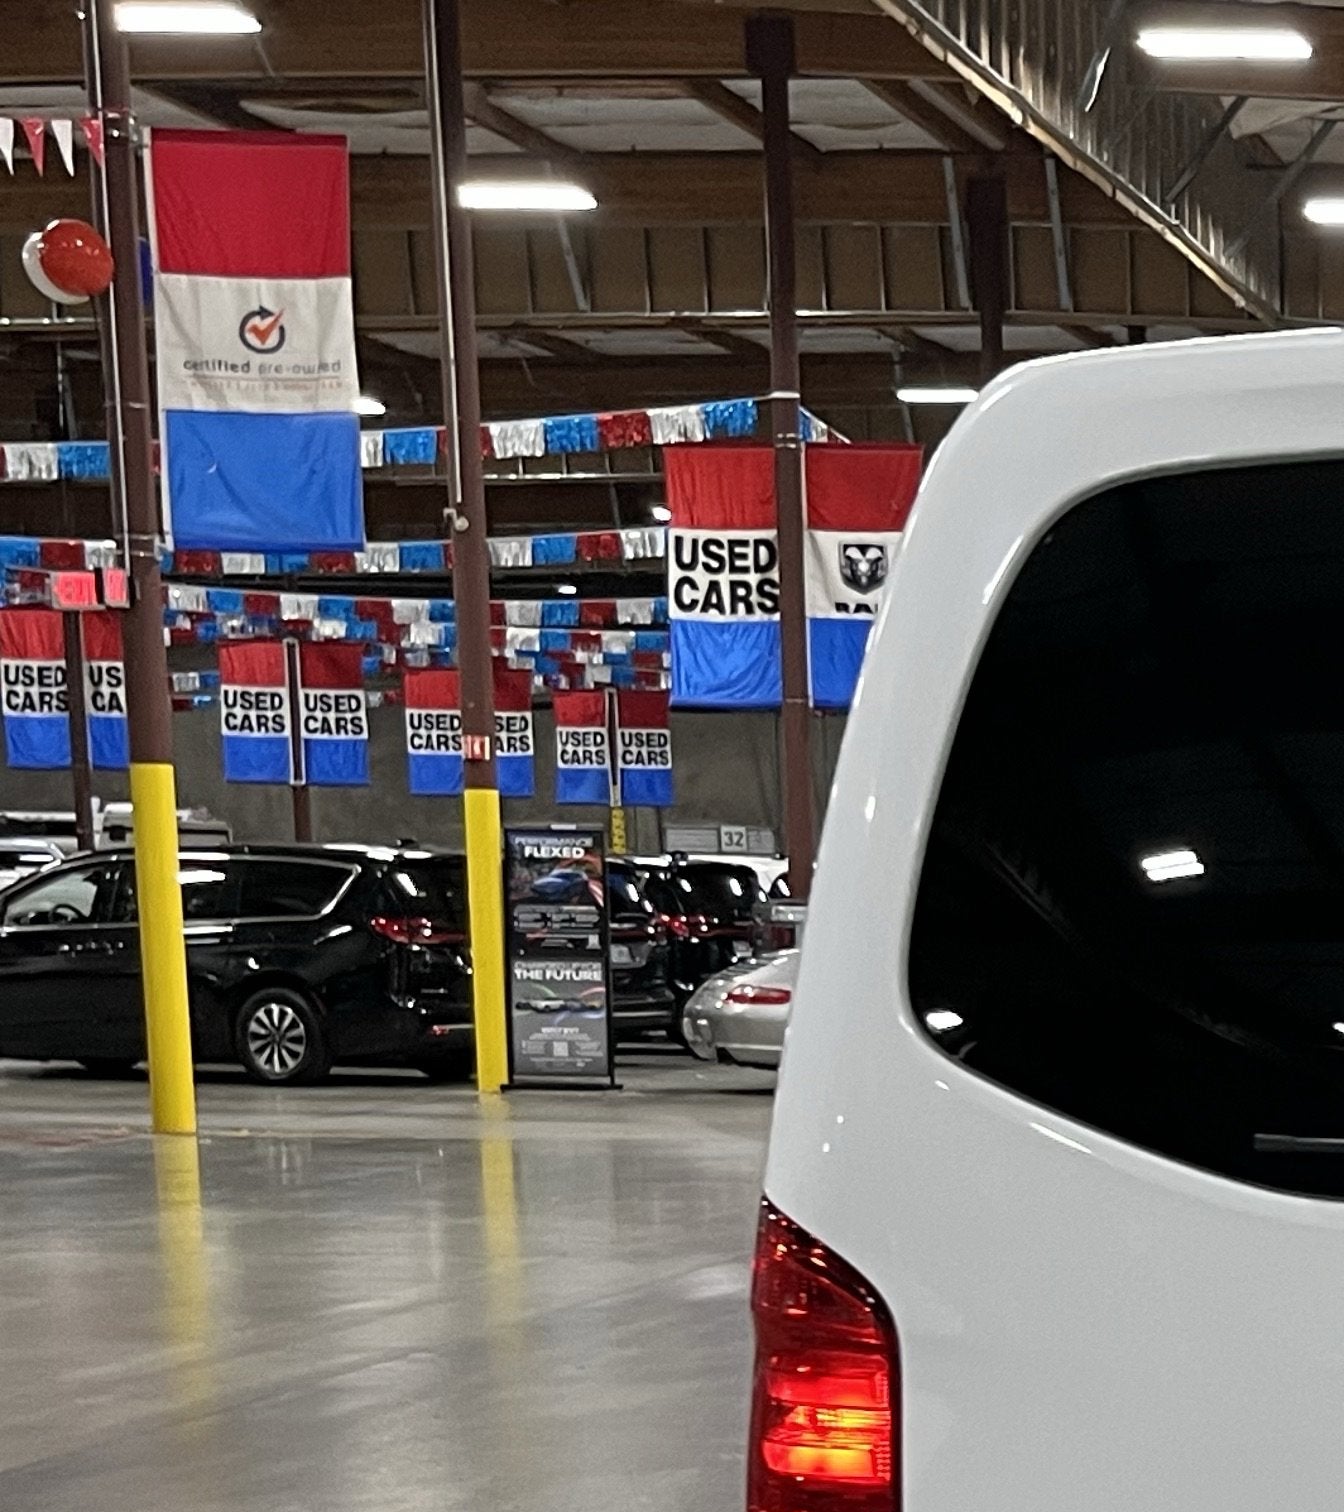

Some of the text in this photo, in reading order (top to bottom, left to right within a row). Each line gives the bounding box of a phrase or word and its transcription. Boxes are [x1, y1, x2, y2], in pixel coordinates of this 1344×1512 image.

[183, 358, 251, 374] certified
[674, 535, 777, 575] USED
[673, 575, 780, 616] CARS
[4, 664, 67, 688] USED
[89, 664, 122, 689] US
[6, 689, 69, 713] CARS
[91, 690, 124, 713] CA
[223, 690, 284, 712] USED
[304, 692, 361, 714] USED
[224, 713, 286, 734] CARS
[304, 715, 364, 736] CARS
[409, 713, 461, 731] USED
[495, 715, 529, 733] SED
[410, 733, 462, 752] CARS
[495, 734, 530, 753] ARS
[559, 731, 605, 747] USED
[621, 731, 668, 748] USED
[560, 748, 606, 766] CARS
[621, 749, 669, 766] CARS
[723, 831, 745, 847] 32
[524, 845, 585, 859] FLEXED
[514, 968, 602, 981] THE FUTURE
